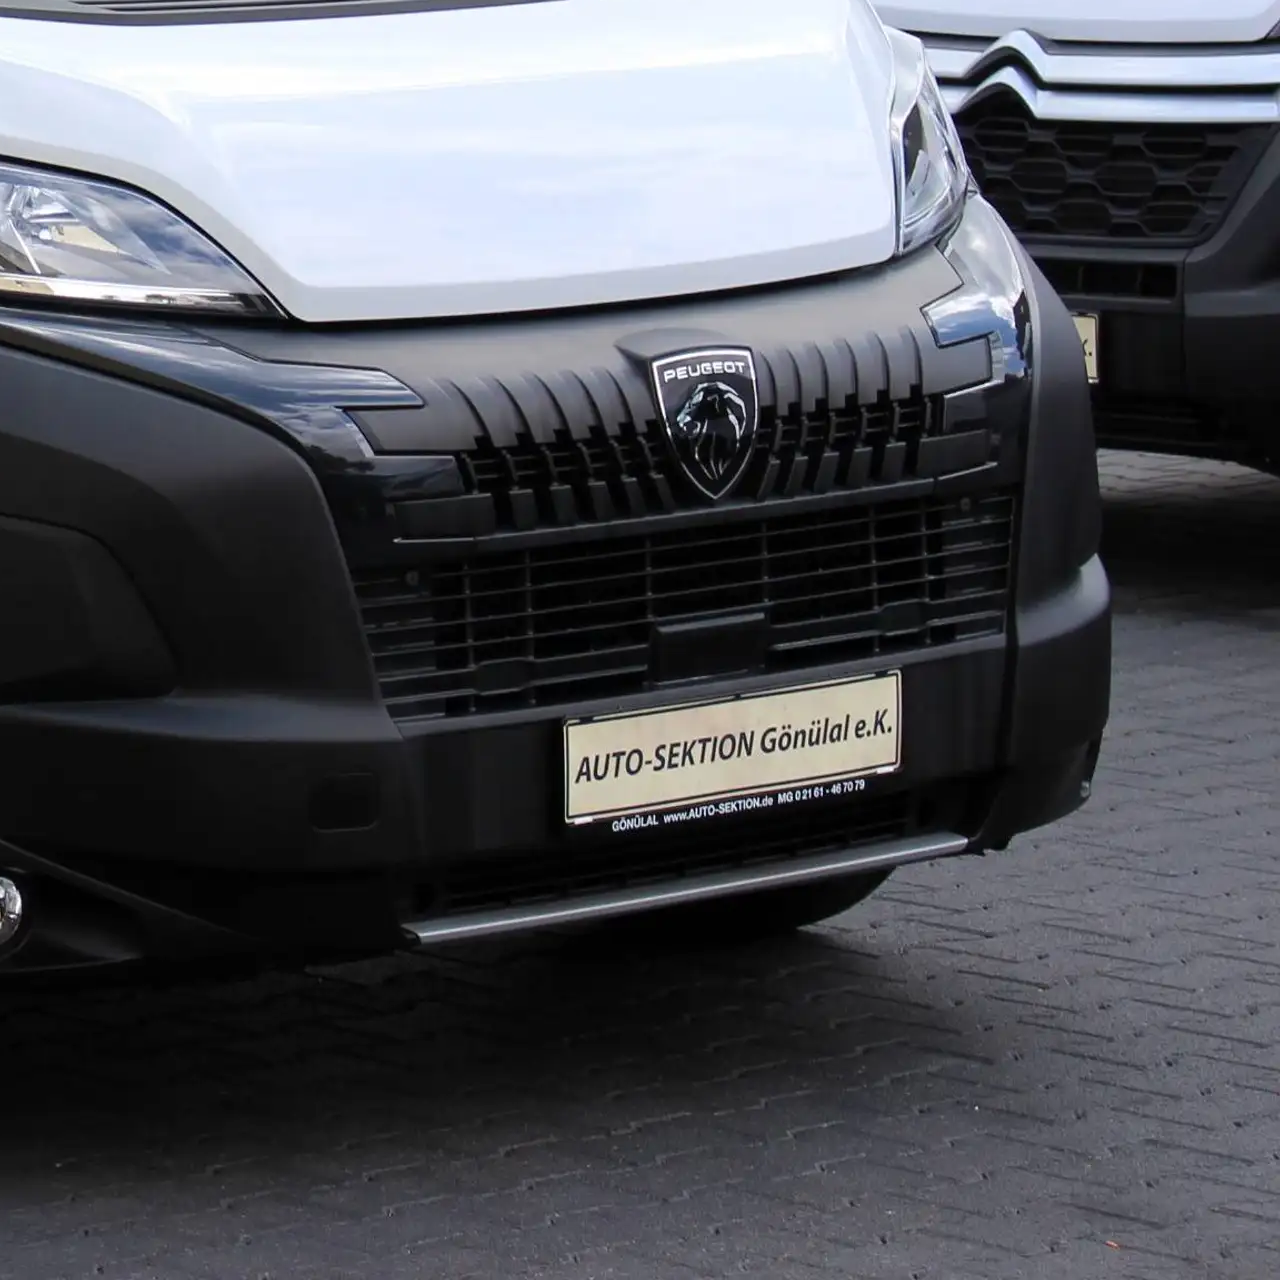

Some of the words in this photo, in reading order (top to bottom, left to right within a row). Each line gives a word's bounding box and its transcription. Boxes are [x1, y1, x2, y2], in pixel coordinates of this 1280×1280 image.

[663, 361, 745, 383] PEUGEOT
[575, 730, 754, 784] AUTO-SEKTION
[760, 713, 850, 755] Gönülal
[855, 708, 892, 739] e.K.
[612, 814, 659, 832] GÖNÜLAL
[663, 795, 773, 824] www.AUTO-SEKTION.de
[777, 791, 794, 805] MG
